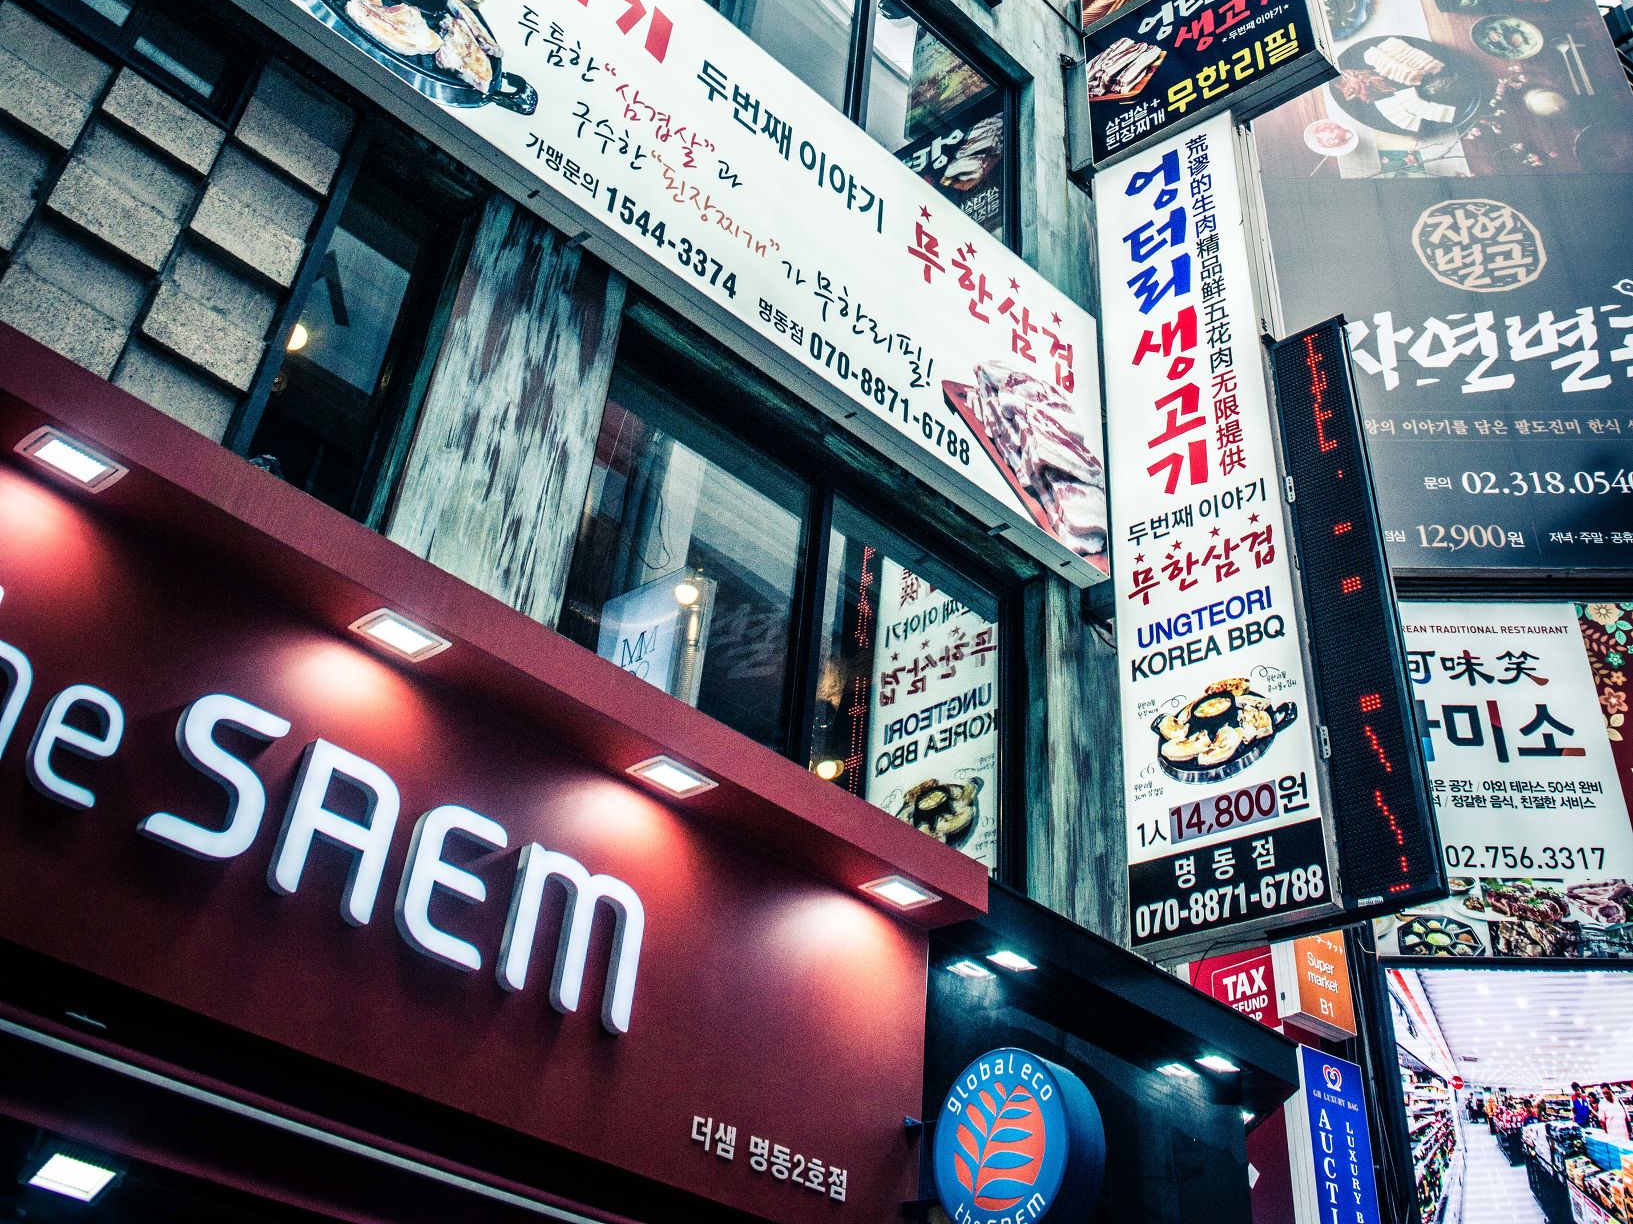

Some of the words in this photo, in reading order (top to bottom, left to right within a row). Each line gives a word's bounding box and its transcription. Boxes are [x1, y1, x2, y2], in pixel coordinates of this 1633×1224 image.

[517, 5, 600, 82] 두툼한
[1229, 20, 1255, 40] 두번째
[1256, 6, 1283, 25] 이야기
[1168, 23, 1299, 113] 무한리필
[572, 101, 648, 170] 구수한
[697, 59, 792, 161] 두번째
[800, 140, 884, 235] 이야기
[1106, 109, 1165, 150] 된장찌개
[526, 132, 600, 199] 가맹문의
[606, 186, 737, 299] 1544-3374
[1426, 208, 1524, 245] 자연
[1435, 242, 1533, 287] 별곡
[907, 221, 1075, 393] 무한삼겹
[758, 297, 805, 346] 명동점
[810, 332, 970, 466] 070-8871-6788
[1132, 305, 1208, 494] 생고기
[1364, 419, 1395, 435] 왕의
[1402, 419, 1468, 436] 이야기를
[1474, 419, 1508, 435] 담은
[1514, 419, 1581, 435] 팔도진미
[1588, 418, 1621, 434] 한식
[1128, 504, 1193, 545] 두번째
[1200, 478, 1266, 518] 이야기
[1423, 476, 1452, 490] 문의
[1461, 468, 1633, 496] 02.318.054
[1128, 524, 1275, 605] 무한삼겹
[1131, 635, 1222, 682] KOREA
[1228, 615, 1285, 652] BBQ
[1137, 586, 1272, 649] UNGTEORI
[1429, 625, 1499, 634] TRADITIONAL
[1501, 626, 1569, 634] RESTAURANT
[1449, 779, 1473, 793] 공간
[1483, 780, 1506, 793] 야외
[1510, 781, 1546, 794] 테라스
[1548, 781, 1576, 794] 50석
[1578, 781, 1603, 795] 완비
[1452, 795, 1487, 808] 정갈한
[1520, 796, 1557, 809] 친절한
[1560, 796, 1597, 809] 서비스
[1445, 845, 1605, 870] 02.756.3317
[1136, 864, 1324, 938] 070-8871-6788
[1222, 965, 1268, 1002] TAX
[1307, 951, 1335, 975] Super
[1308, 971, 1339, 994] market
[1319, 997, 1334, 1018] B1
[947, 1053, 1014, 1116] global
[1020, 1063, 1053, 1101] eco
[691, 1115, 737, 1160] 더샘
[749, 1135, 848, 1202] 명동2호점
[1345, 1121, 1362, 1205] LUXURY
[954, 1203, 980, 1224] th
